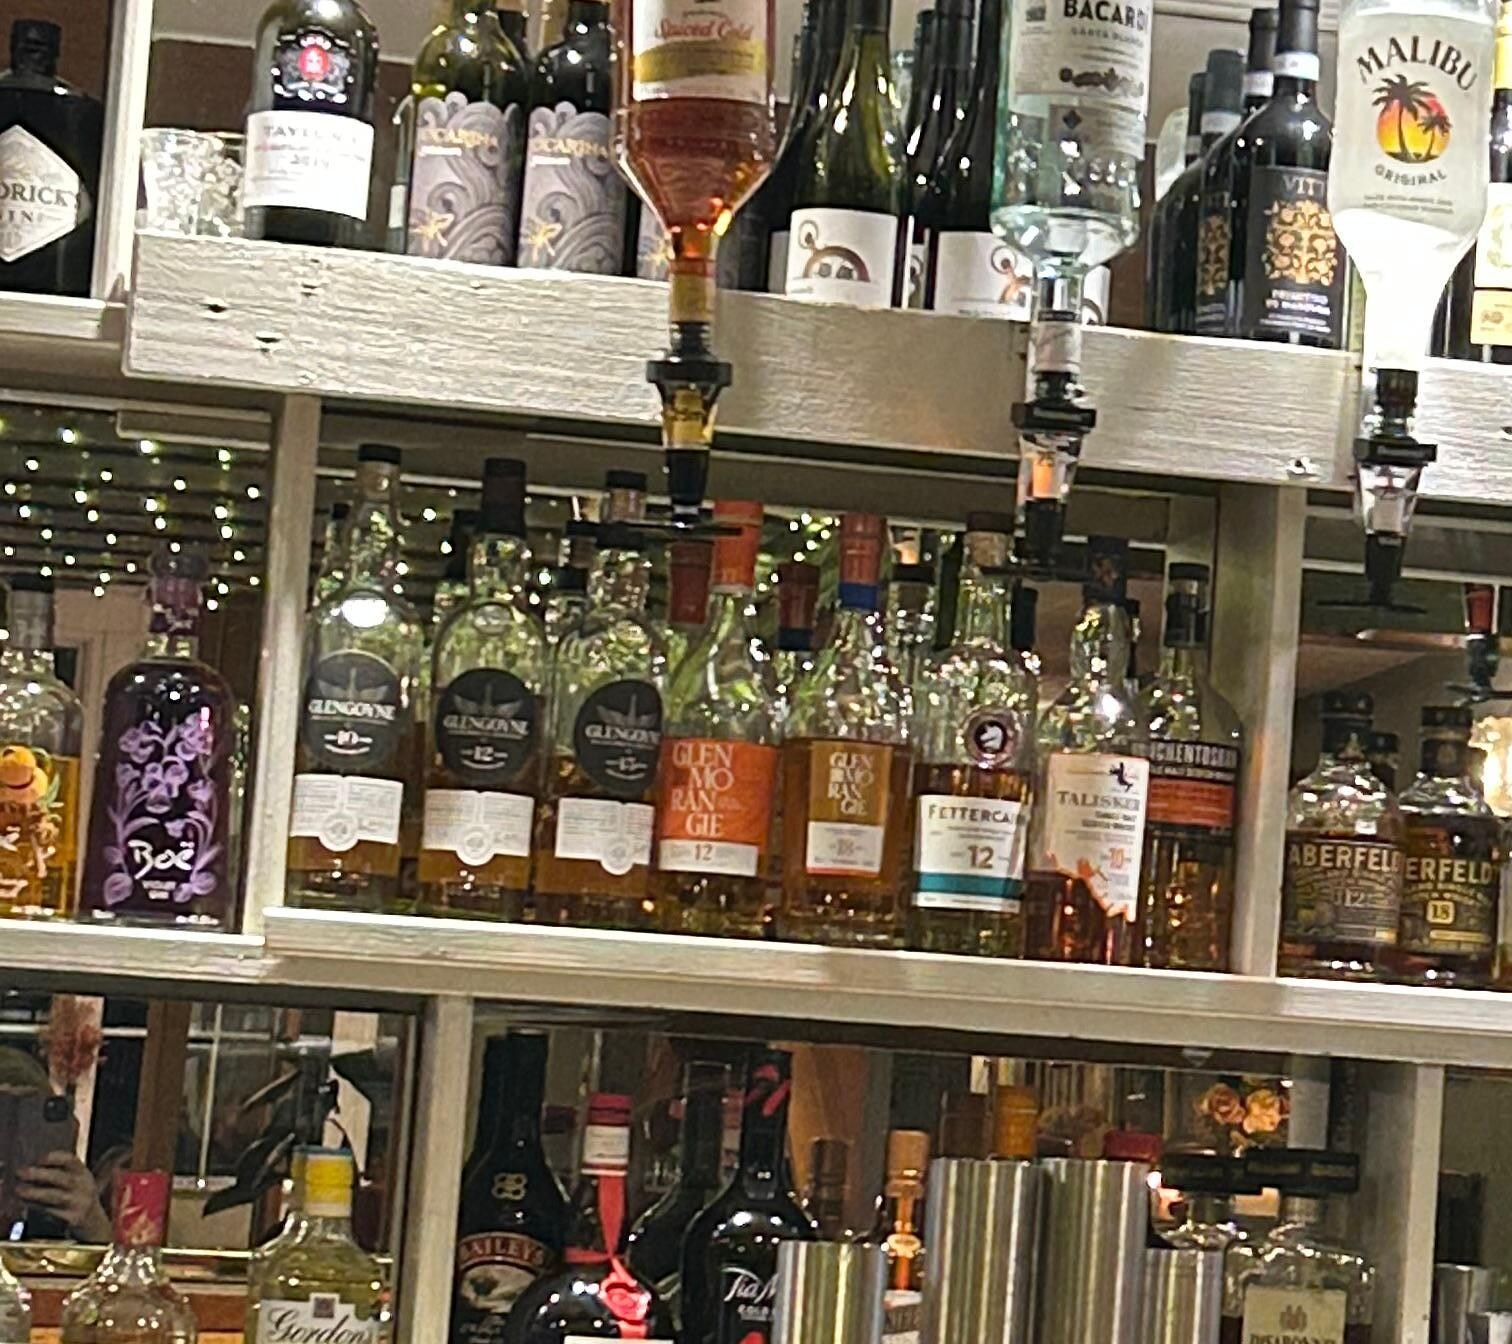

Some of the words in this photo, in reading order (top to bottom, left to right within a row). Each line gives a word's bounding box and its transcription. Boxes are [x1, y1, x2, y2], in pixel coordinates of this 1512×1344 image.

[1356, 36, 1478, 91] MALIBU
[1375, 164, 1447, 186] ORIGINAL
[308, 698, 397, 722] GLENGOYNE
[442, 713, 530, 737] GLENGOYNE
[671, 742, 736, 769] GLEN
[690, 766, 736, 793] MO
[669, 789, 718, 813] RAN
[684, 812, 725, 838] GIE
[693, 843, 714, 862] 12
[967, 844, 995, 869] 12
